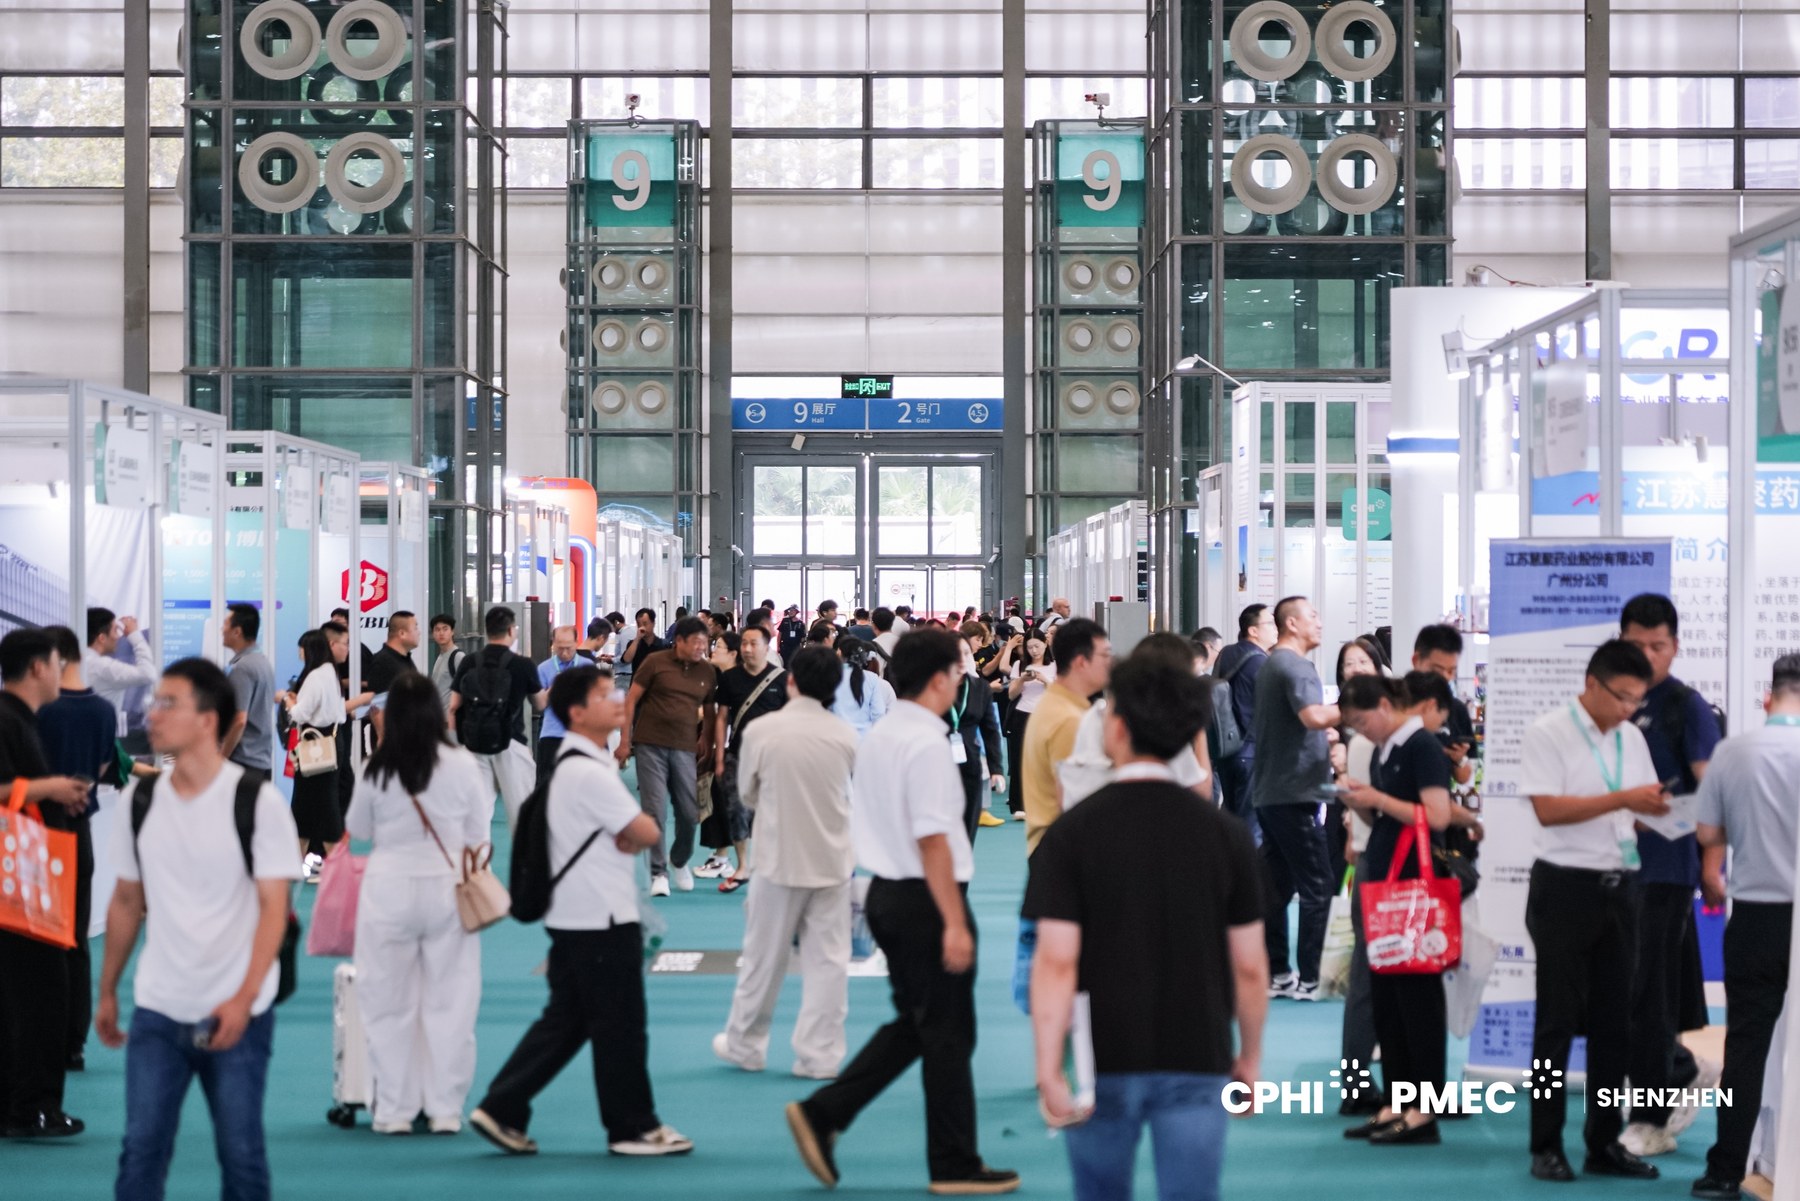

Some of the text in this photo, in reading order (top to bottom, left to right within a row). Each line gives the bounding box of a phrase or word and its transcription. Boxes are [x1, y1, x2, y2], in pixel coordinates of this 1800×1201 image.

[612, 149, 651, 211] 9
[1082, 149, 1122, 211] 9
[876, 382, 891, 390] EXIT
[794, 402, 837, 423] 9 展厅
[897, 402, 940, 423] 2 号门
